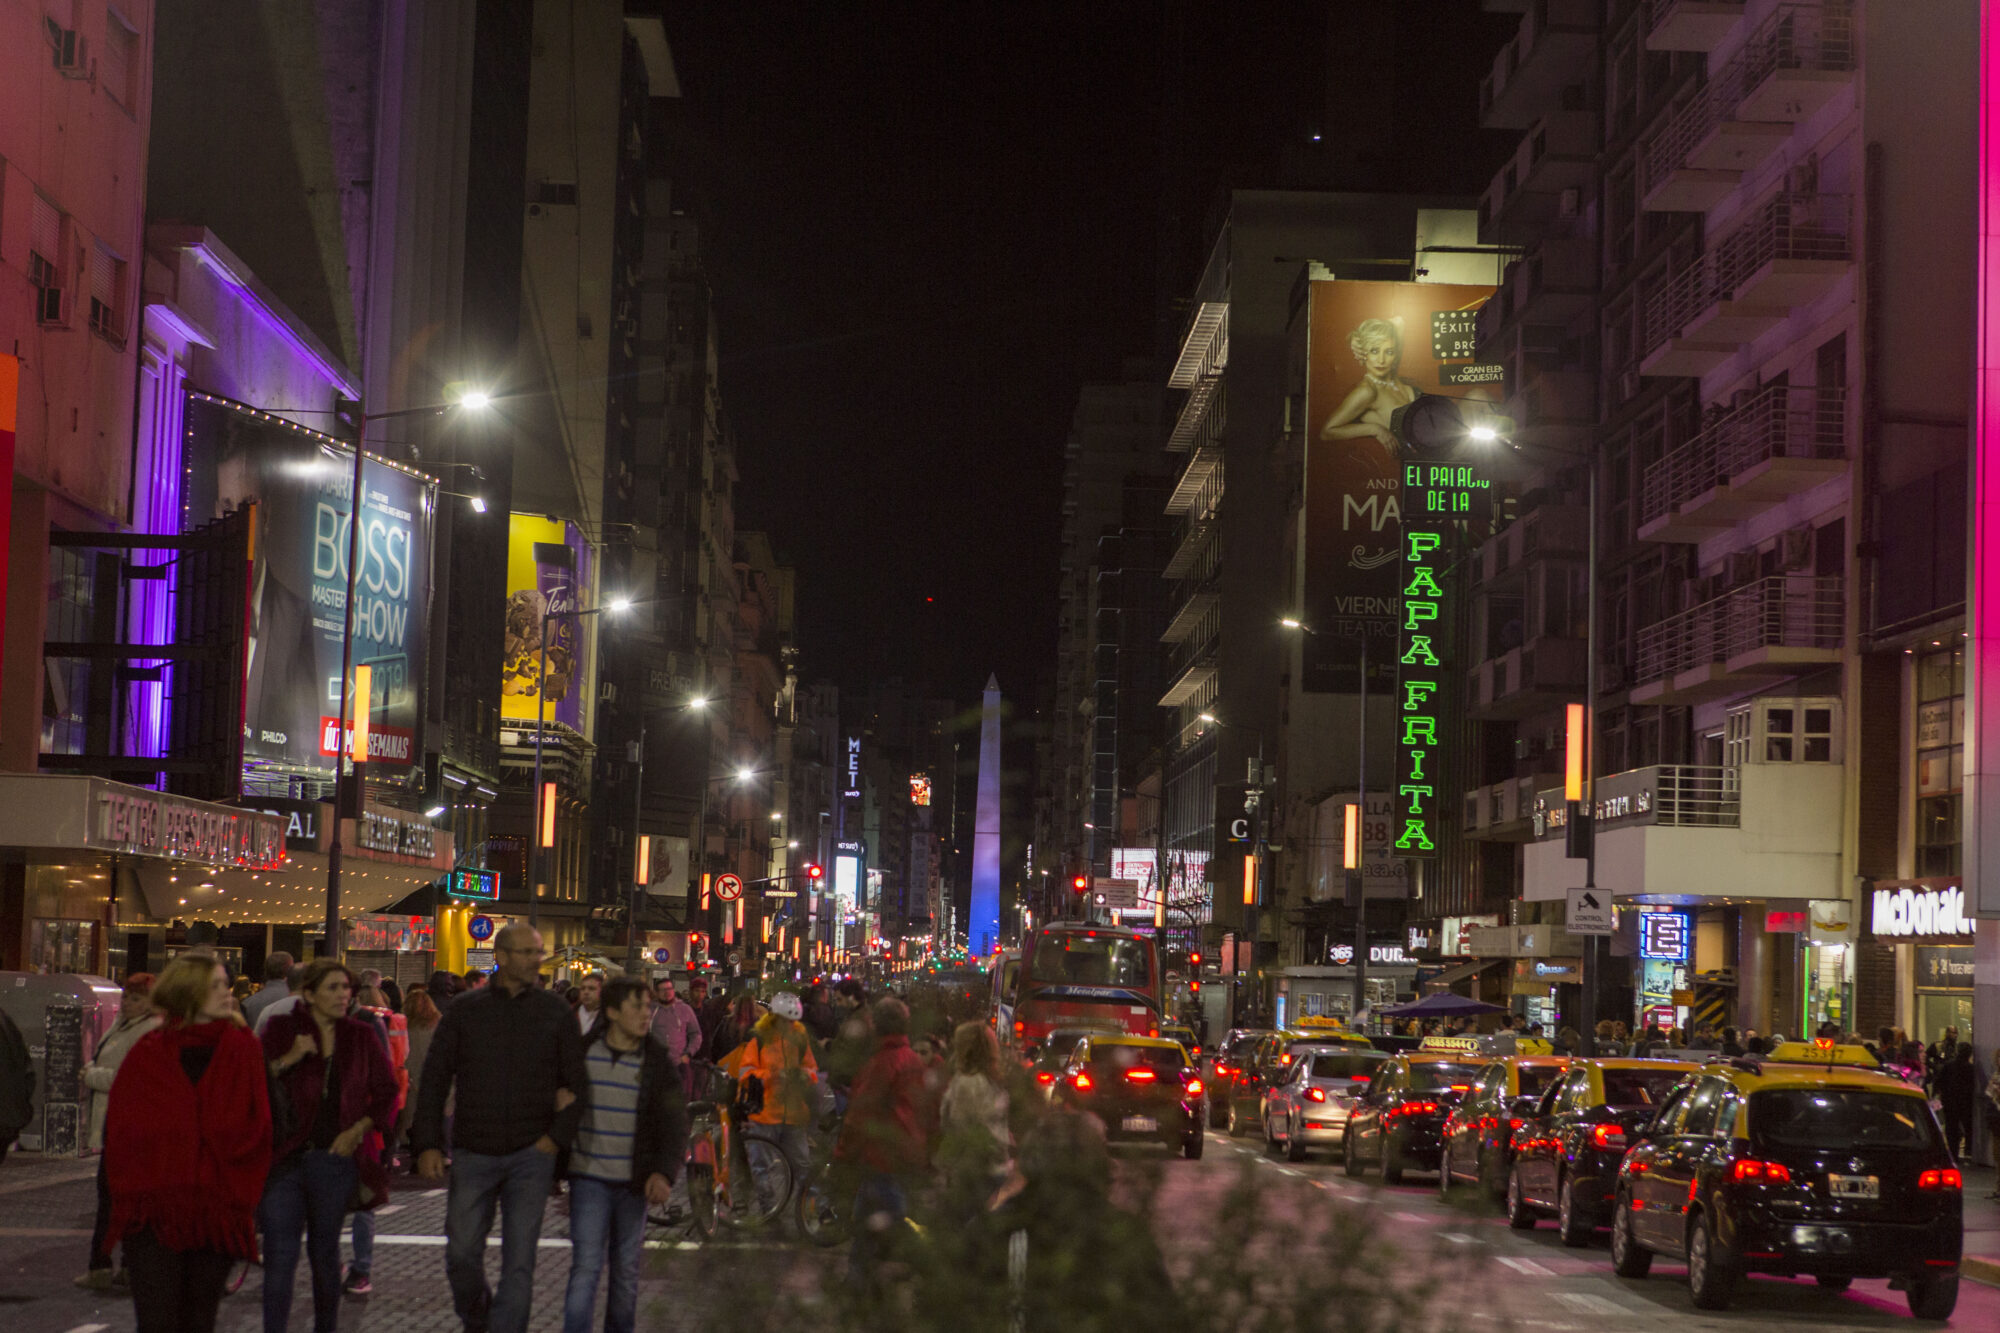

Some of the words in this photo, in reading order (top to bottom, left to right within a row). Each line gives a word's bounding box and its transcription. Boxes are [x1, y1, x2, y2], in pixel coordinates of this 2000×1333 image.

[1457, 374, 1498, 382] ORQUESTA
[1463, 366, 1485, 374] GRAN
[1407, 466, 1423, 487] EL
[1427, 491, 1446, 511] DE
[314, 502, 411, 601] BOSSI
[1401, 532, 1443, 666] PAPA
[370, 664, 403, 697] 019
[368, 732, 409, 759] SEMANAS
[848, 736, 860, 787] MET
[1395, 681, 1438, 850] FRITA
[1872, 886, 1975, 936] McDonald
[1330, 946, 1353, 961] 365
